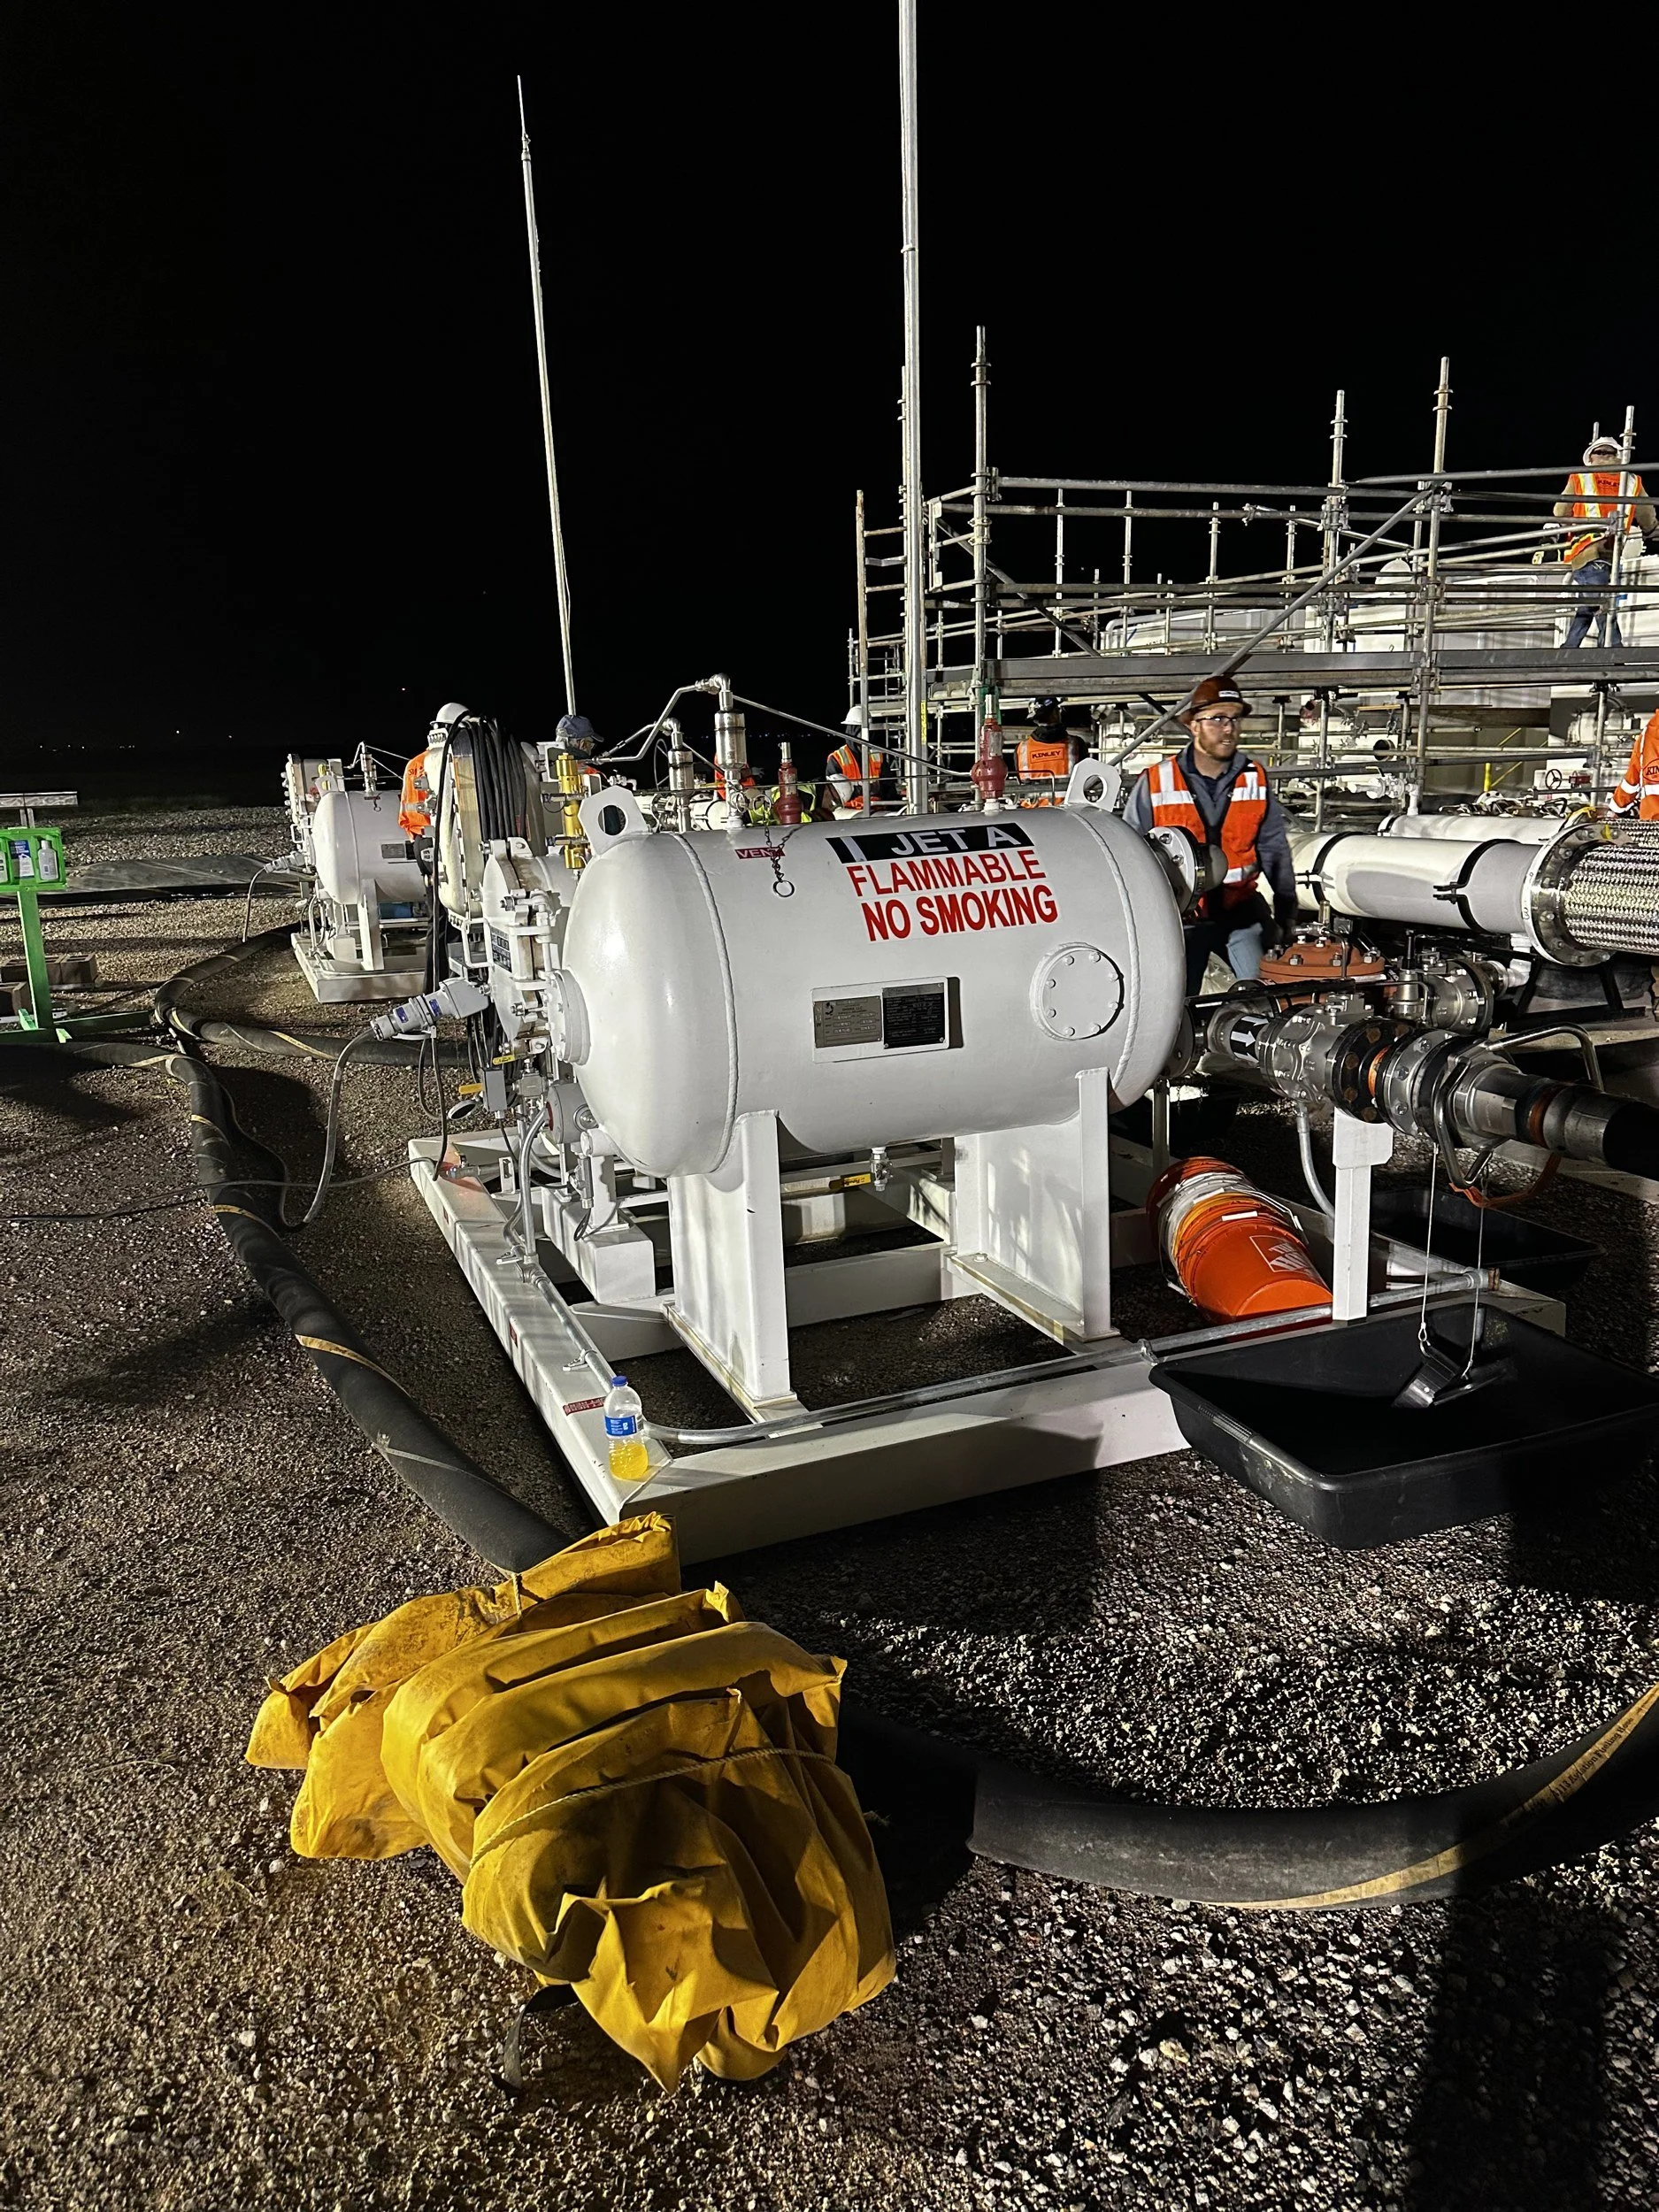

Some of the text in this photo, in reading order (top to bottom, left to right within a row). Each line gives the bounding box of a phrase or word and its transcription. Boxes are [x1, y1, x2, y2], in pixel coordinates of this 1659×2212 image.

[891, 826, 1021, 856] JET A
[846, 849, 1047, 897] FLAMMABLE
[861, 884, 1058, 942] NO SMOKING
[1568, 1755, 1598, 1784] Aviation
[1594, 1732, 1623, 1757] Fueling
